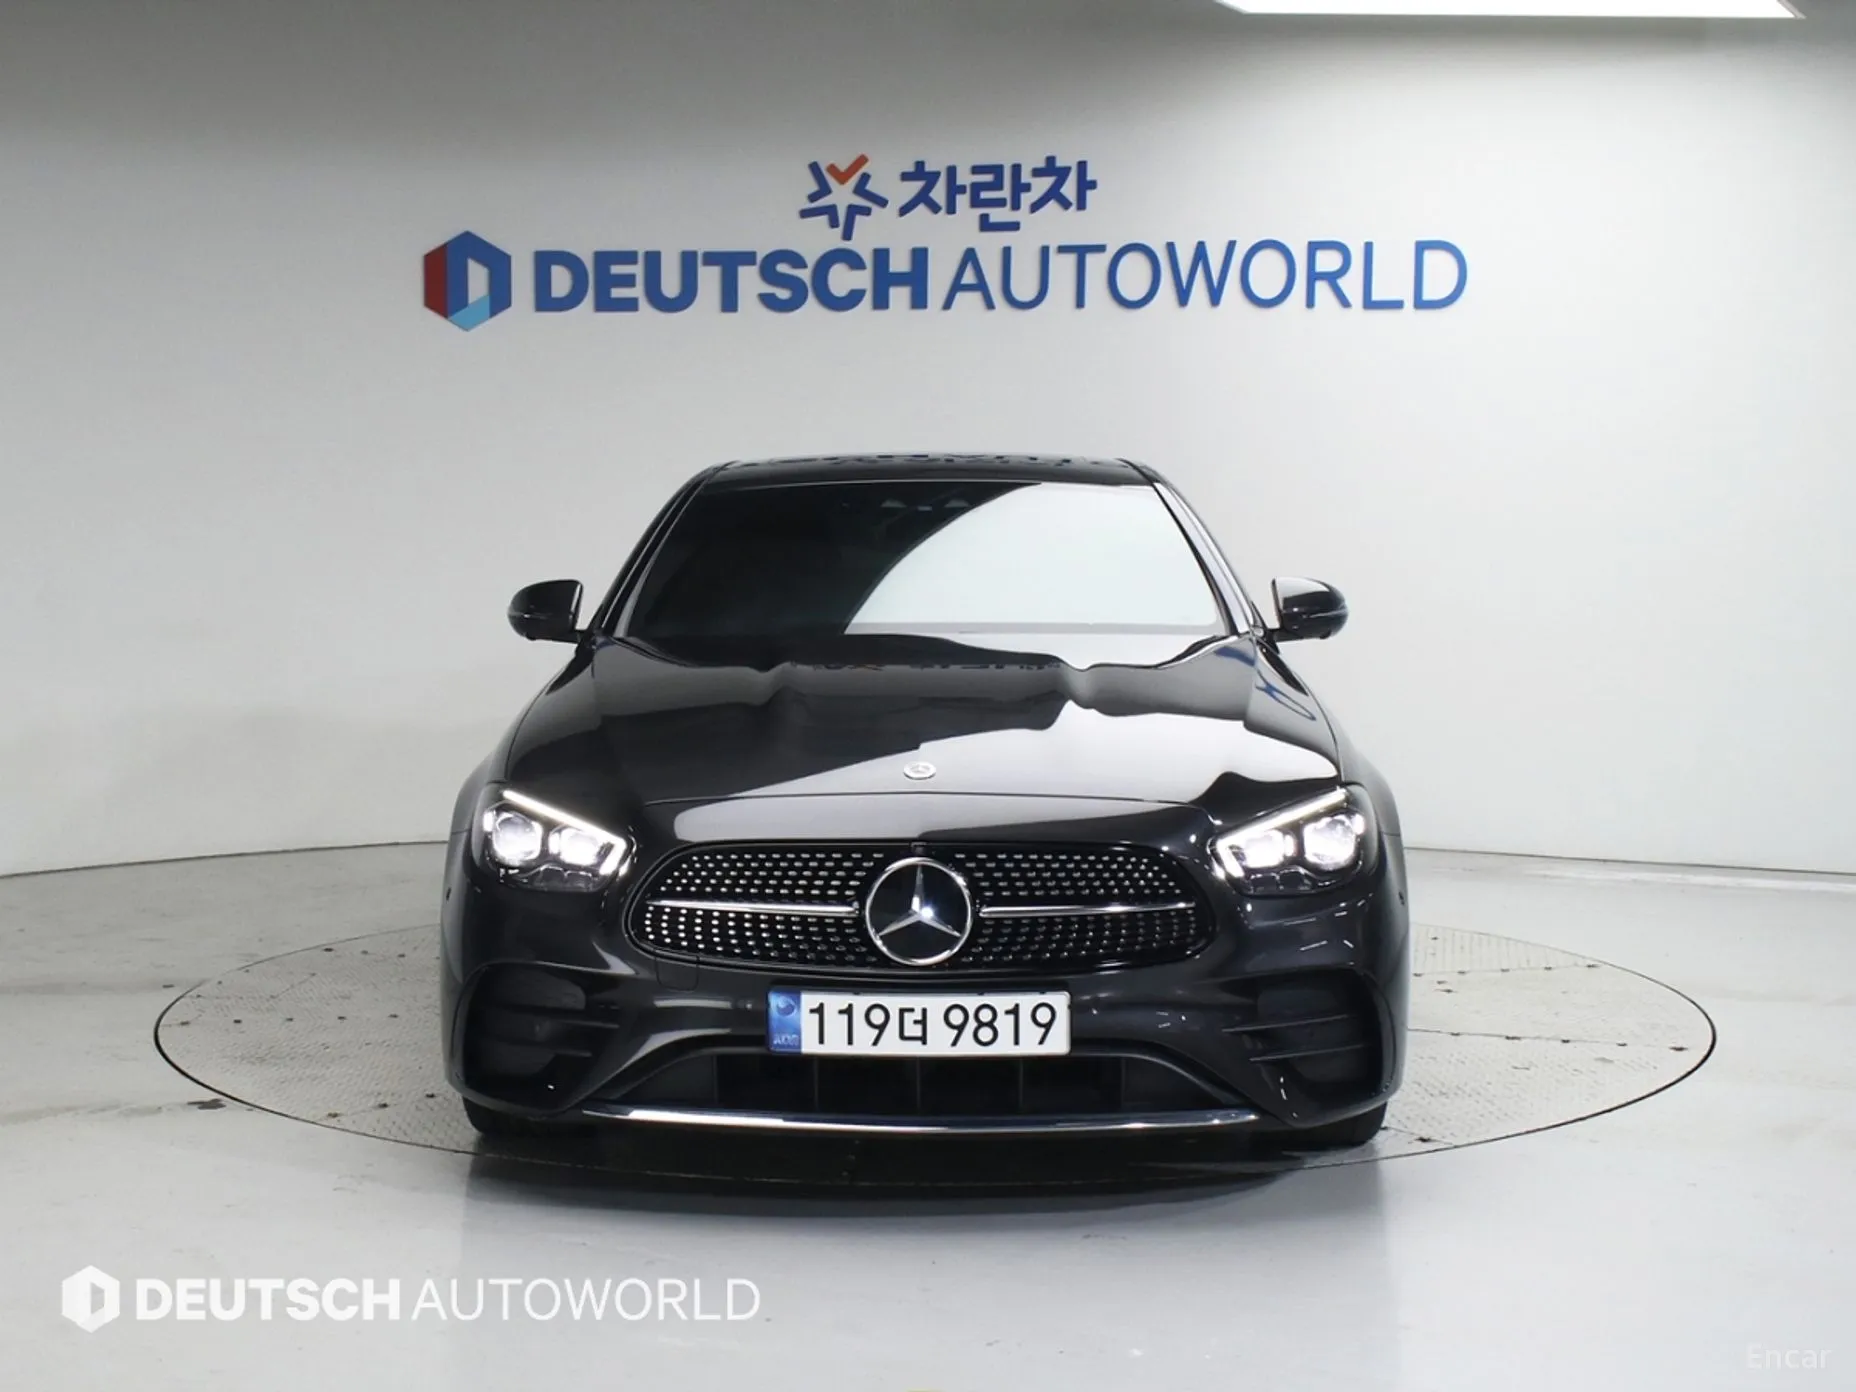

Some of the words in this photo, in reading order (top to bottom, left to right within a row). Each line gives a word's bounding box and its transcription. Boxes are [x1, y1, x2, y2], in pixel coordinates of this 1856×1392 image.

[898, 155, 1098, 232] 차란차
[534, 246, 930, 313] DEUTSCH
[942, 238, 1469, 312] AUTOWORLD
[808, 1002, 928, 1047] 119더
[943, 1002, 1057, 1047] 9819
